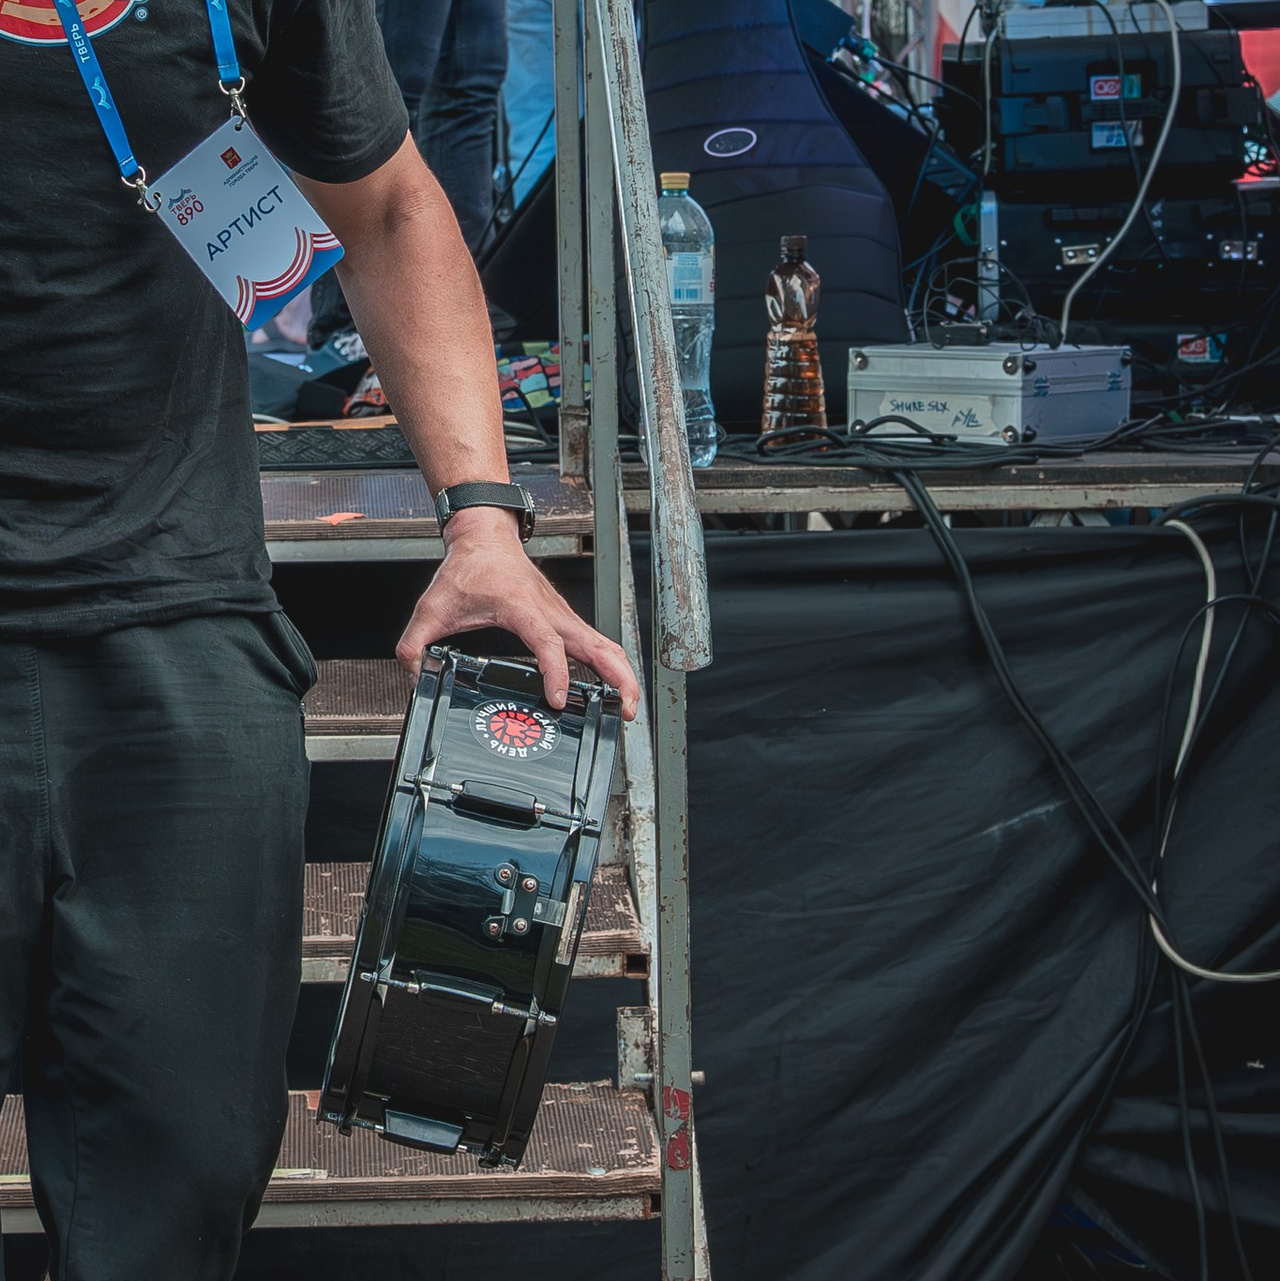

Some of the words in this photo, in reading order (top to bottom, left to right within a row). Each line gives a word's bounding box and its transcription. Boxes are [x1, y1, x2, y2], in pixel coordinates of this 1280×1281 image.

[70, 23, 90, 64] ТВЕРЬ
[170, 193, 197, 216] ТВЕРЬ
[176, 200, 204, 227] 890
[206, 185, 284, 262] АРТИСТ
[475, 702, 518, 732] ЛУЧШИЙ
[532, 712, 556, 750] САМЫЙ
[489, 739, 528, 758] ДЕНЬ
